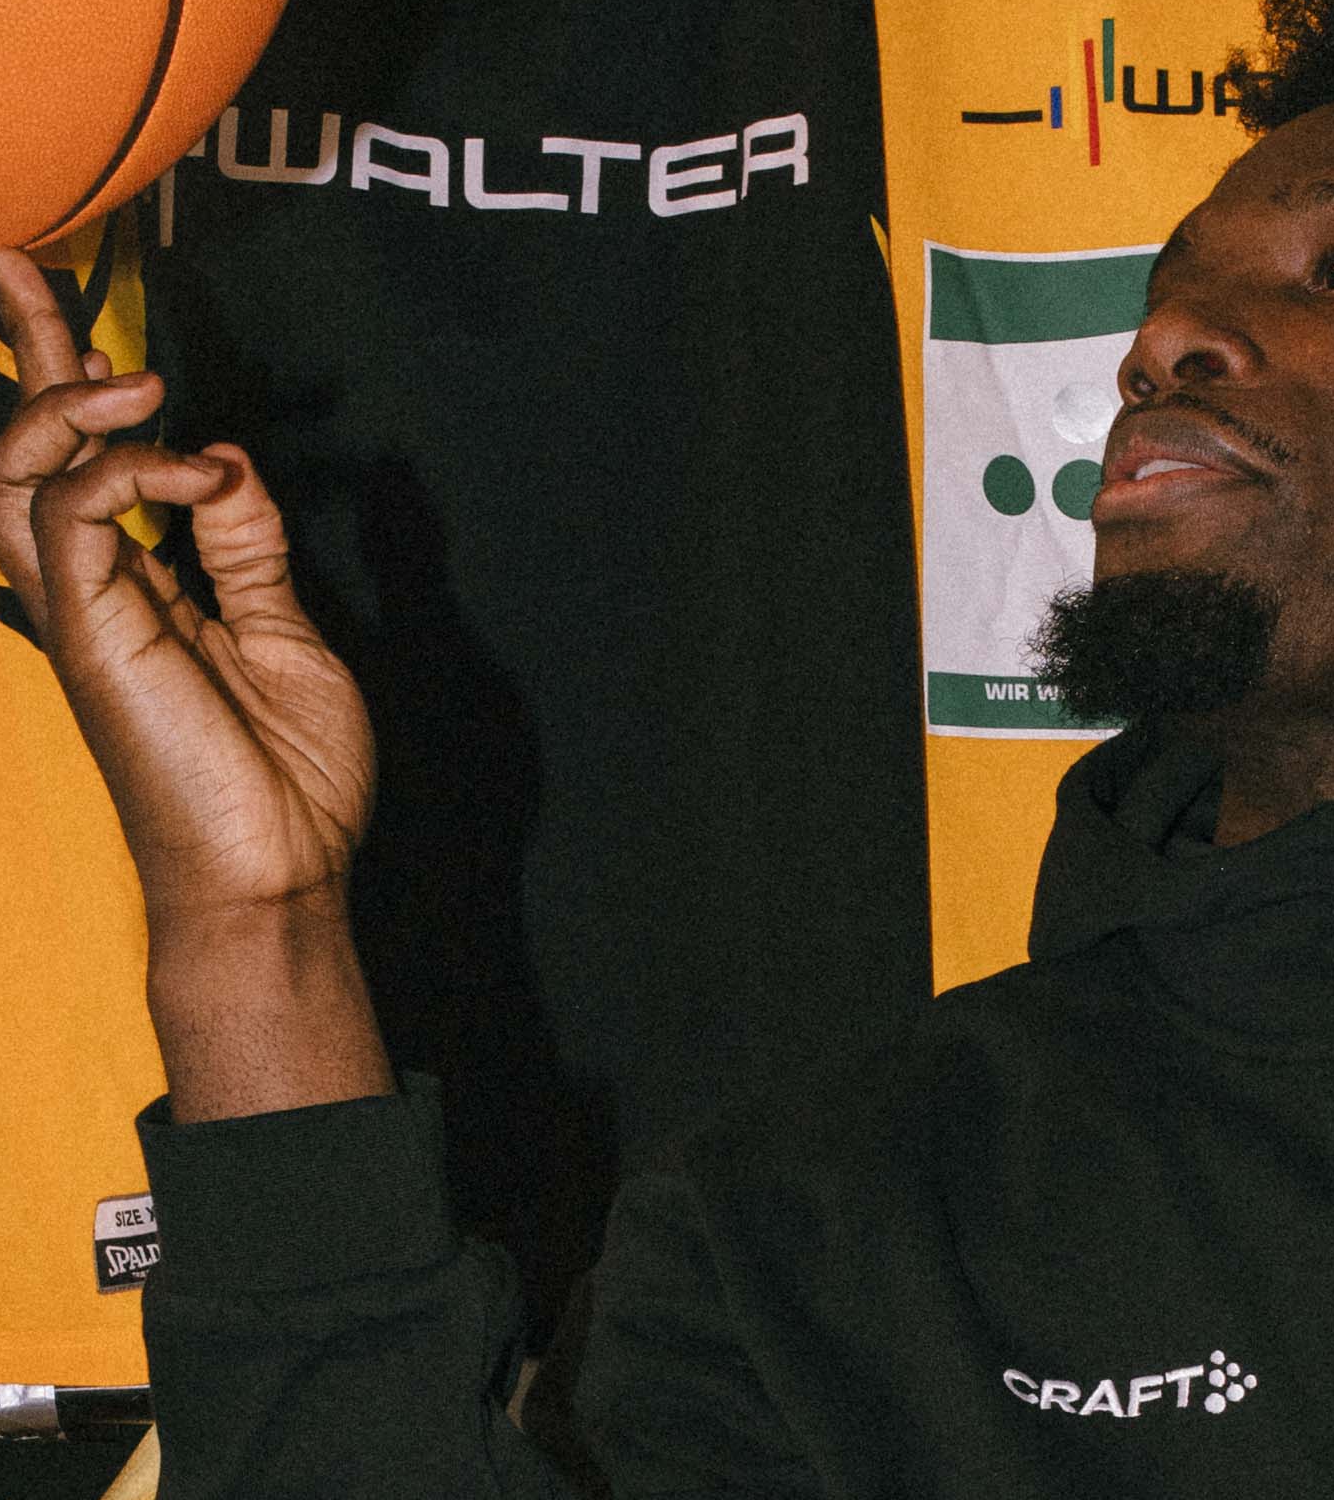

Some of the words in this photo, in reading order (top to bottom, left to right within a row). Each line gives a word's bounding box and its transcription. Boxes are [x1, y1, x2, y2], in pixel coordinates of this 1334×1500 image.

[217, 106, 810, 218] WALTER
[984, 682, 1030, 701] WIR
[115, 1208, 145, 1227] SIZE
[105, 1243, 162, 1278] SPALD
[1003, 1364, 1205, 1418] CRAFT
